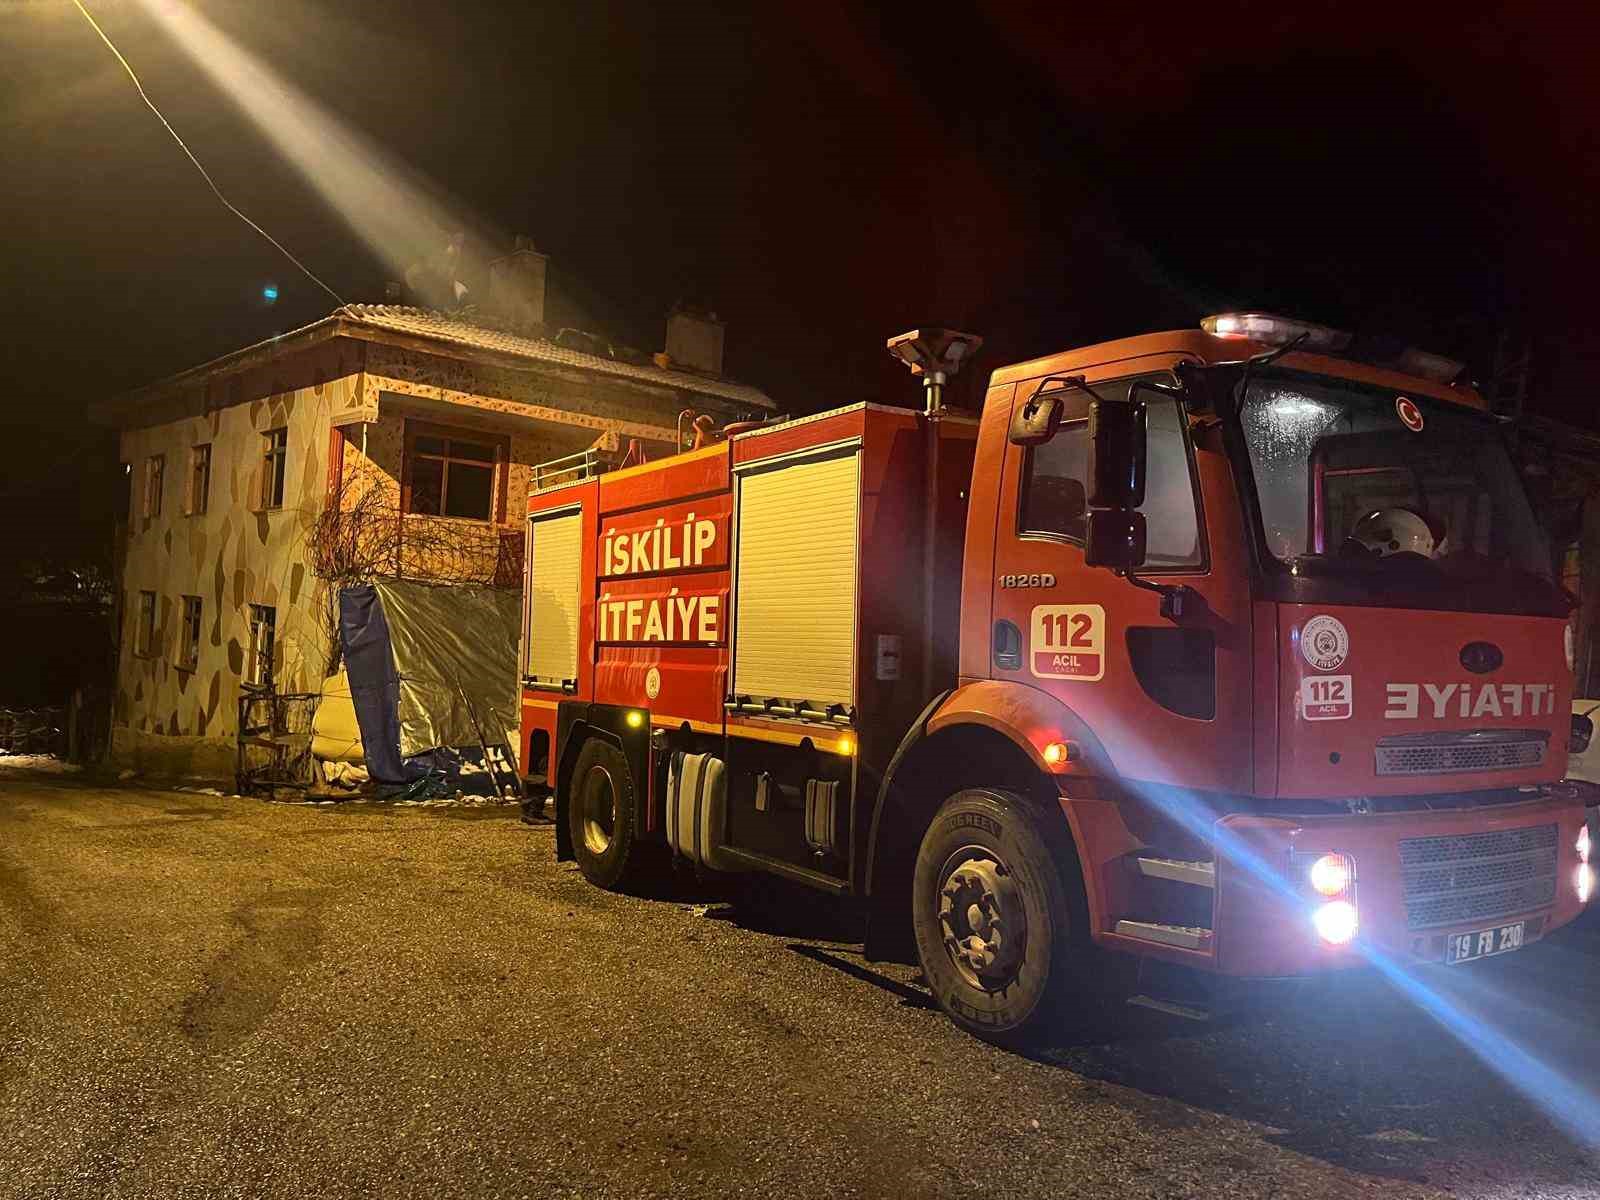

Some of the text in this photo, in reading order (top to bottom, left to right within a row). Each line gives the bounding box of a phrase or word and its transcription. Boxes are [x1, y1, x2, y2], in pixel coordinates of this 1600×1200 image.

[604, 512, 716, 576] İSKİLİP
[999, 573, 1056, 588] 1826D
[600, 588, 720, 641] İTFAİYE
[1042, 613, 1092, 647] 112
[1310, 681, 1345, 701] 112
[1456, 935, 1471, 959] 19
[1500, 925, 1522, 950] 230
